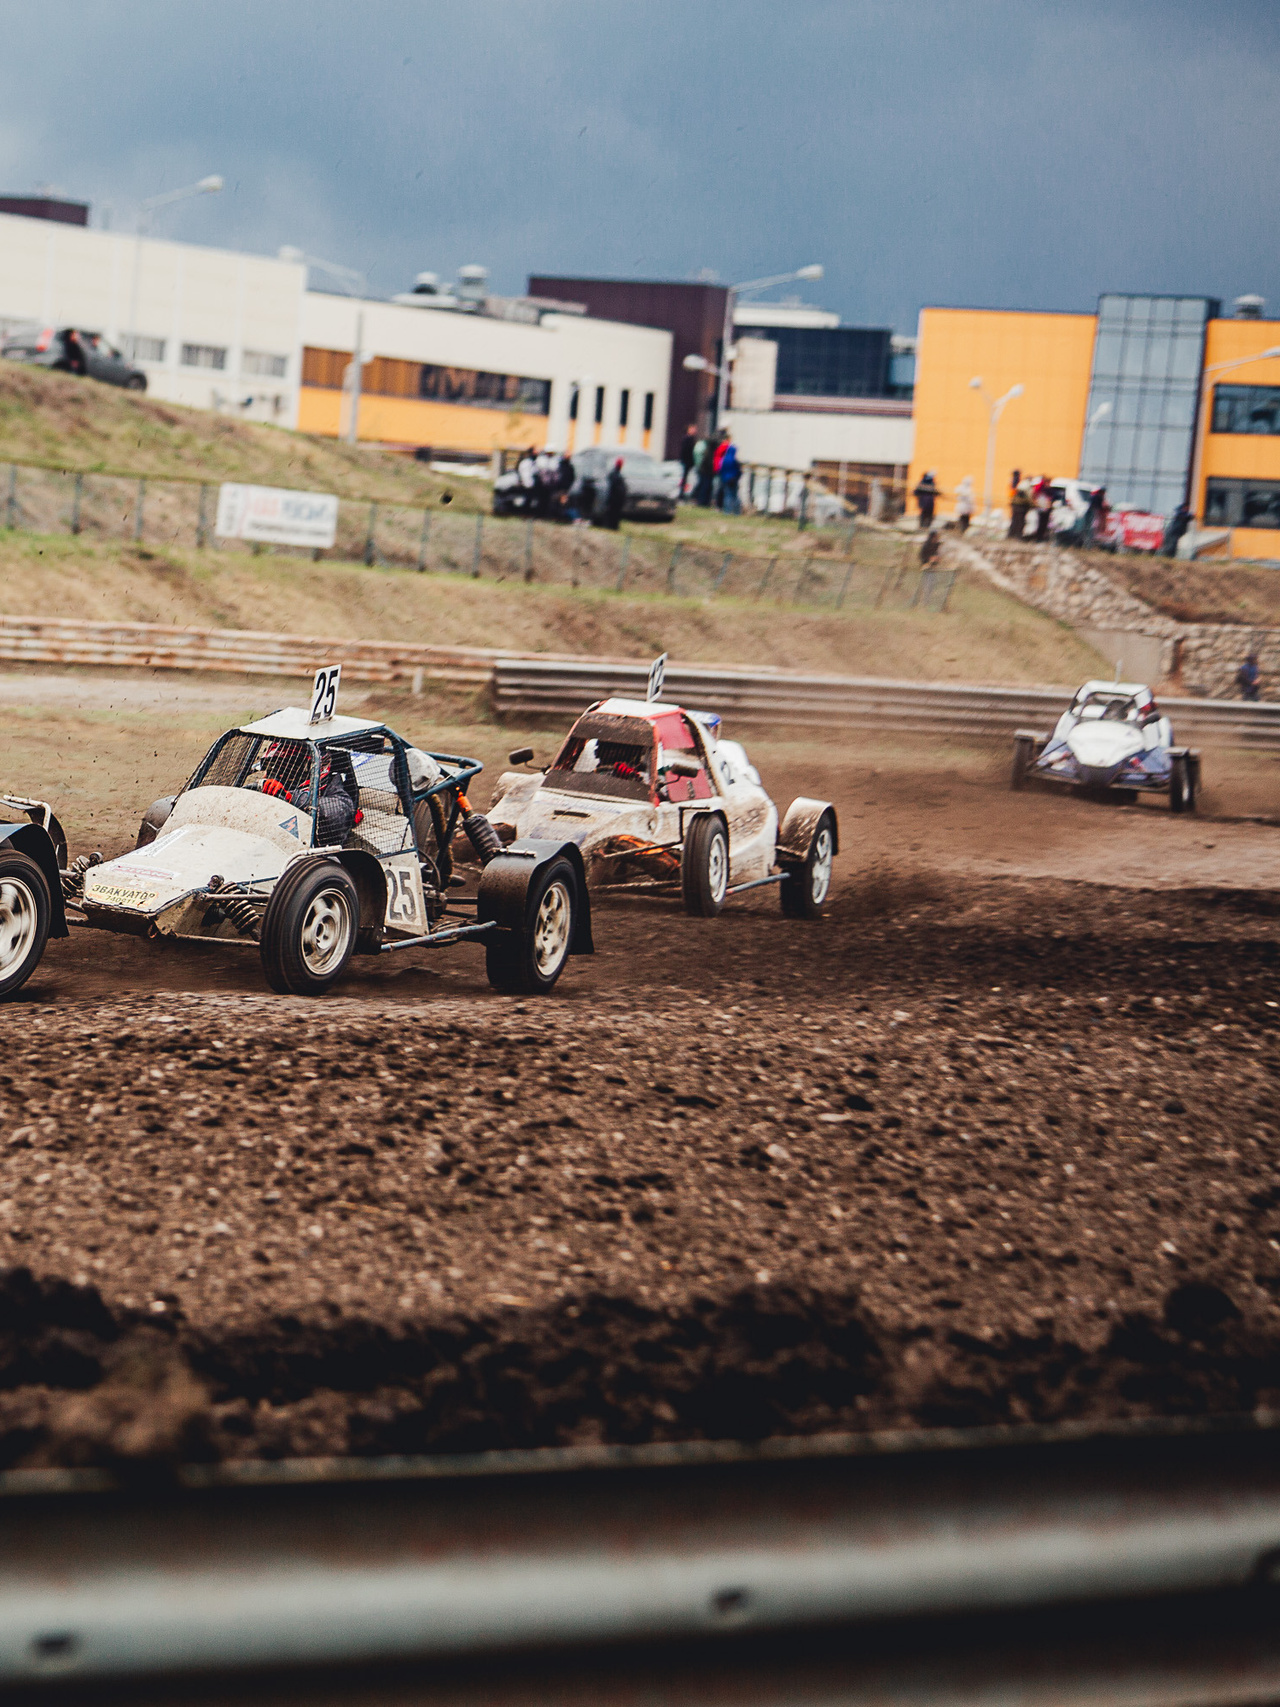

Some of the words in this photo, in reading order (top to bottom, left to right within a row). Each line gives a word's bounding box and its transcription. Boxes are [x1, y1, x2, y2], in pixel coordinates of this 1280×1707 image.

[313, 669, 339, 721] 25
[650, 659, 665, 698] 12
[386, 869, 417, 923] 25
